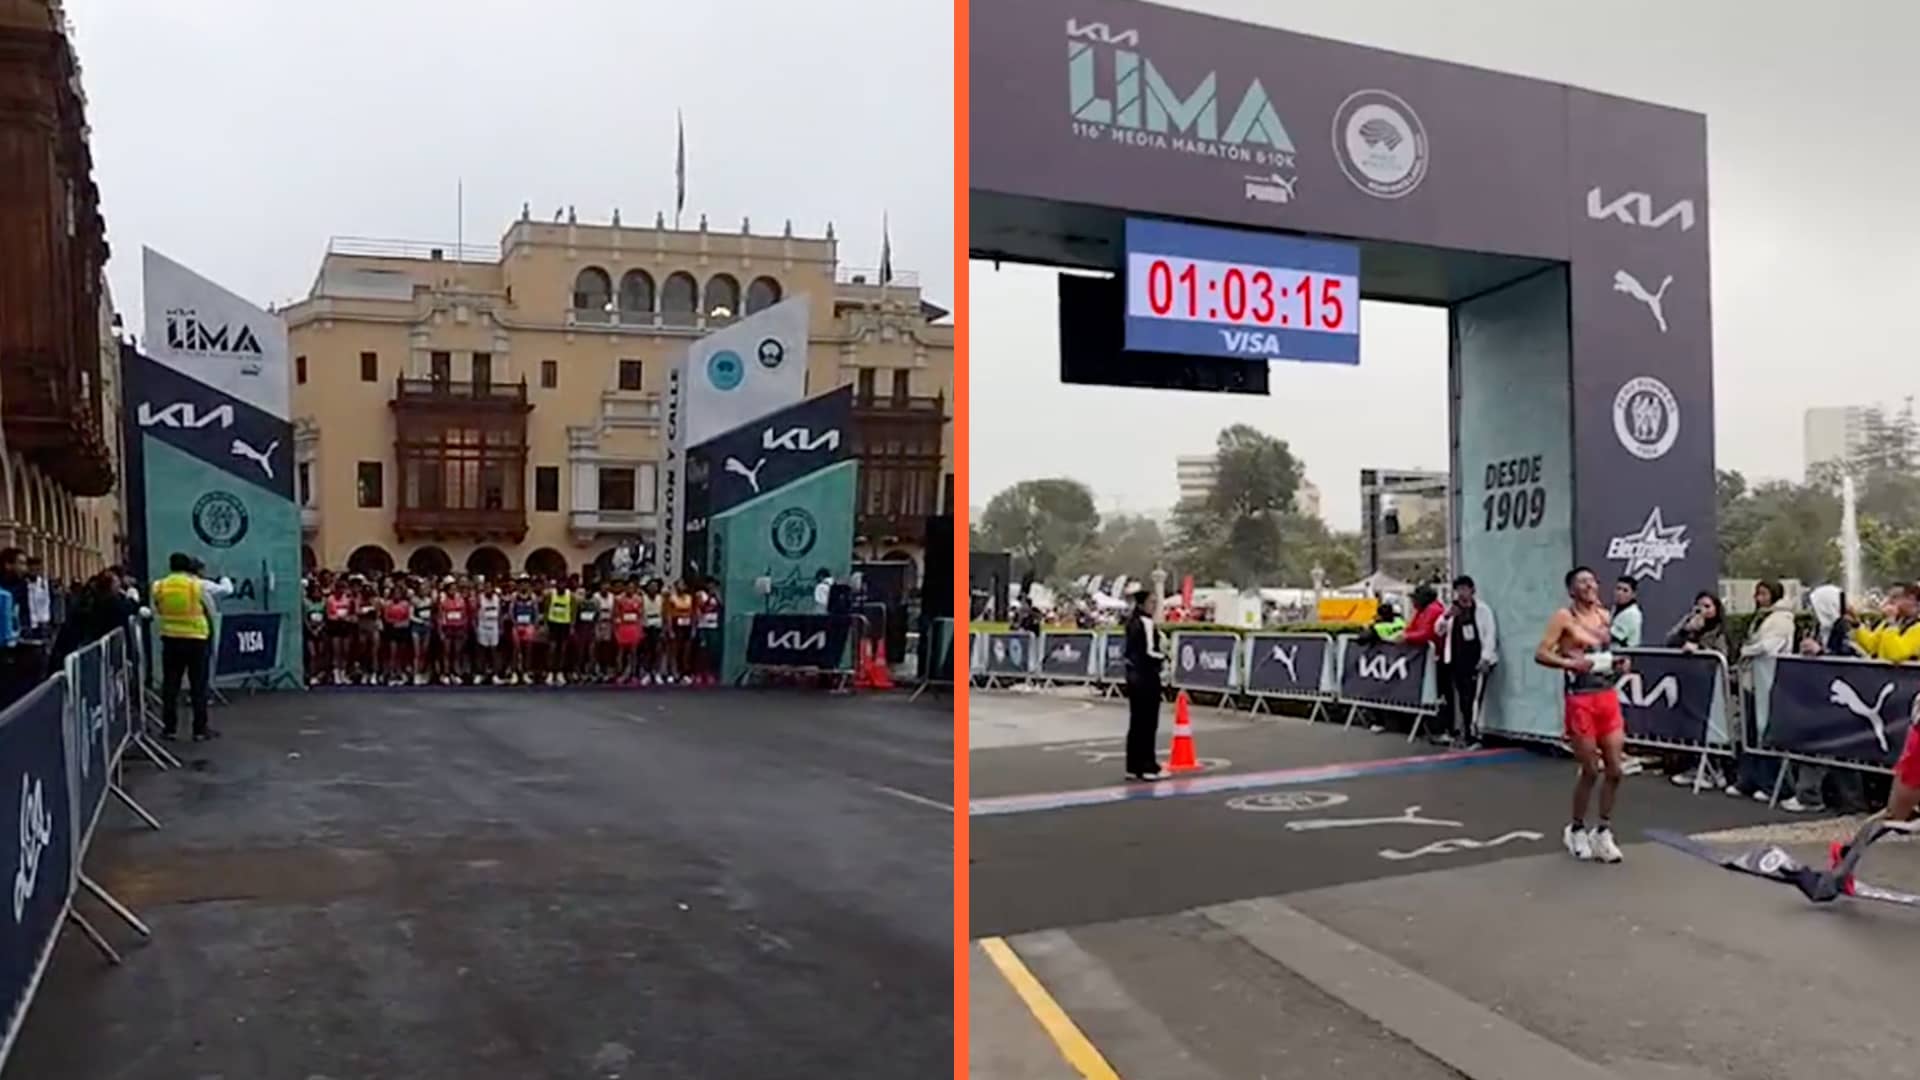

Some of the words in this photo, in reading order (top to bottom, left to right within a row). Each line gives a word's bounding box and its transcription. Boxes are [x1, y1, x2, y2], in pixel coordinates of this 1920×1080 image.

[1066, 18, 1139, 47] KIA
[1068, 40, 1296, 154] LIMA
[1112, 128, 1167, 149] MEDIA
[1587, 185, 1695, 232] KIA
[1147, 259, 1344, 329] 01:03:15
[166, 318, 262, 354] LIMA
[1219, 329, 1281, 355] VISA
[137, 402, 234, 429] KIA
[667, 368, 679, 441] CALLE
[762, 427, 840, 451] KIA
[666, 447, 675, 461] Y
[1485, 454, 1543, 491] DESDE
[1483, 487, 1547, 532] 1909
[236, 631, 264, 652] VISA
[767, 630, 827, 650] KIA
[1359, 654, 1408, 680] KIA
